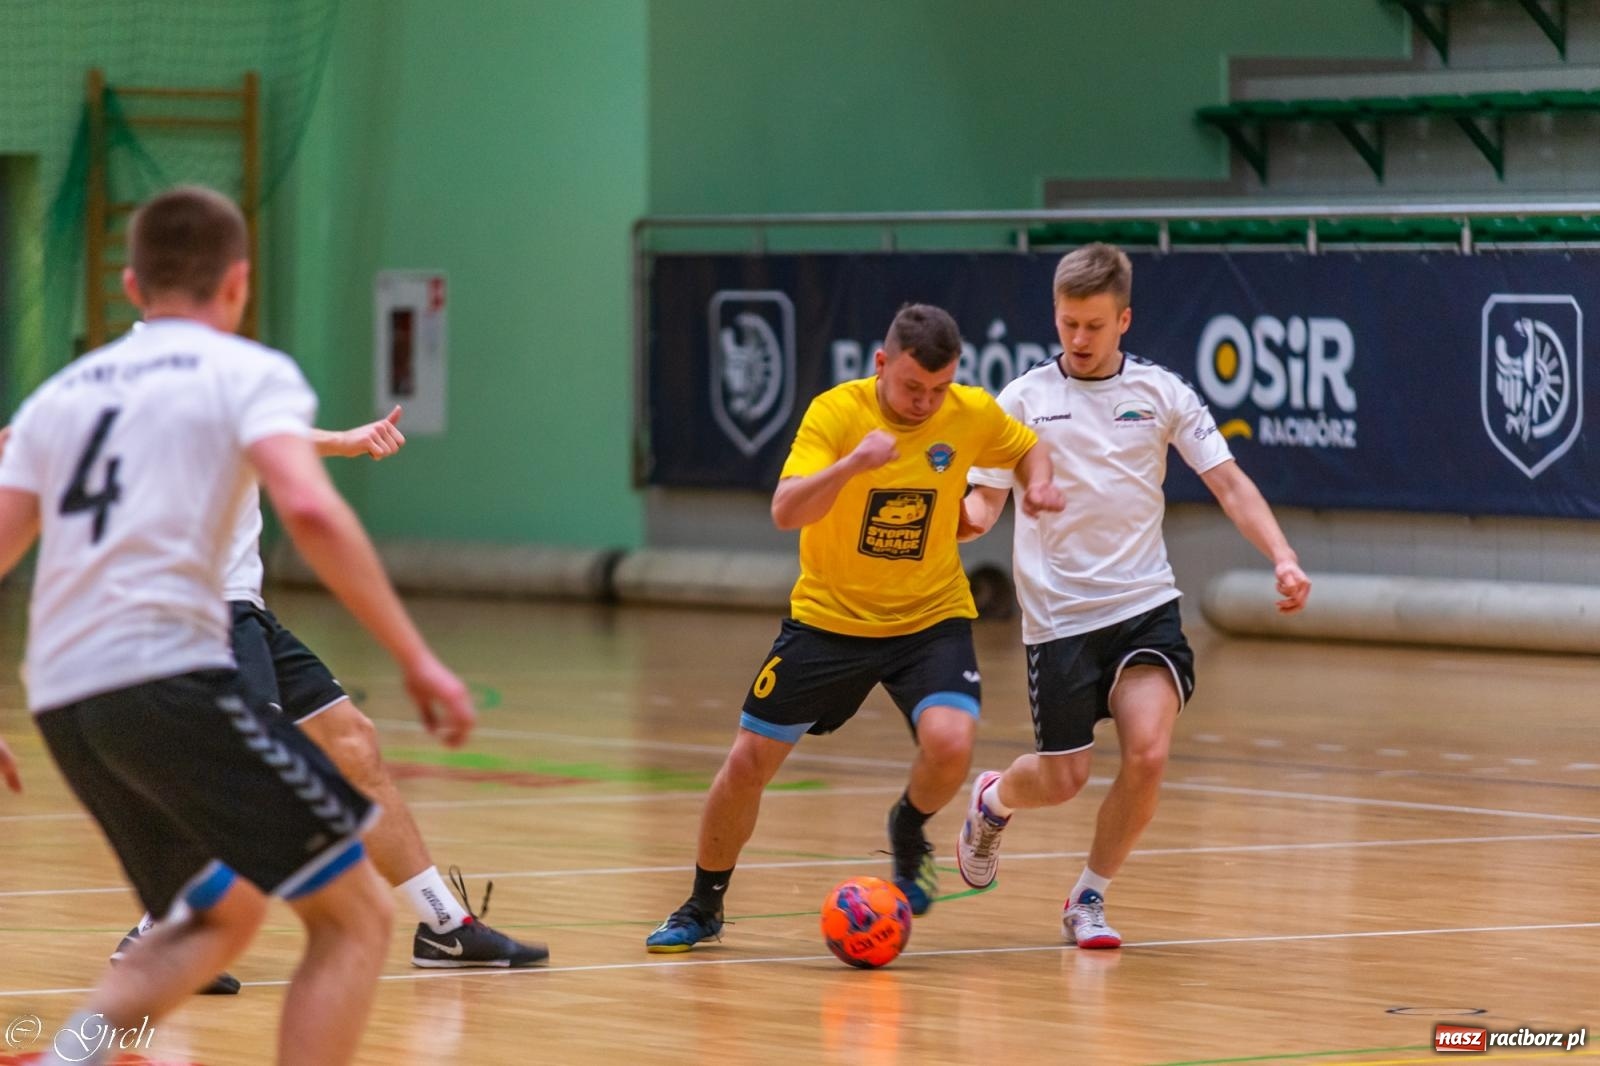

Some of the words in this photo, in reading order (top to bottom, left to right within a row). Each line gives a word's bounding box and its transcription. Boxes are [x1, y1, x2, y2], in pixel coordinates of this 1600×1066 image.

[1258, 411, 1358, 449] RACIBÓRZ
[58, 406, 121, 545] 4
[753, 656, 783, 699] 6
